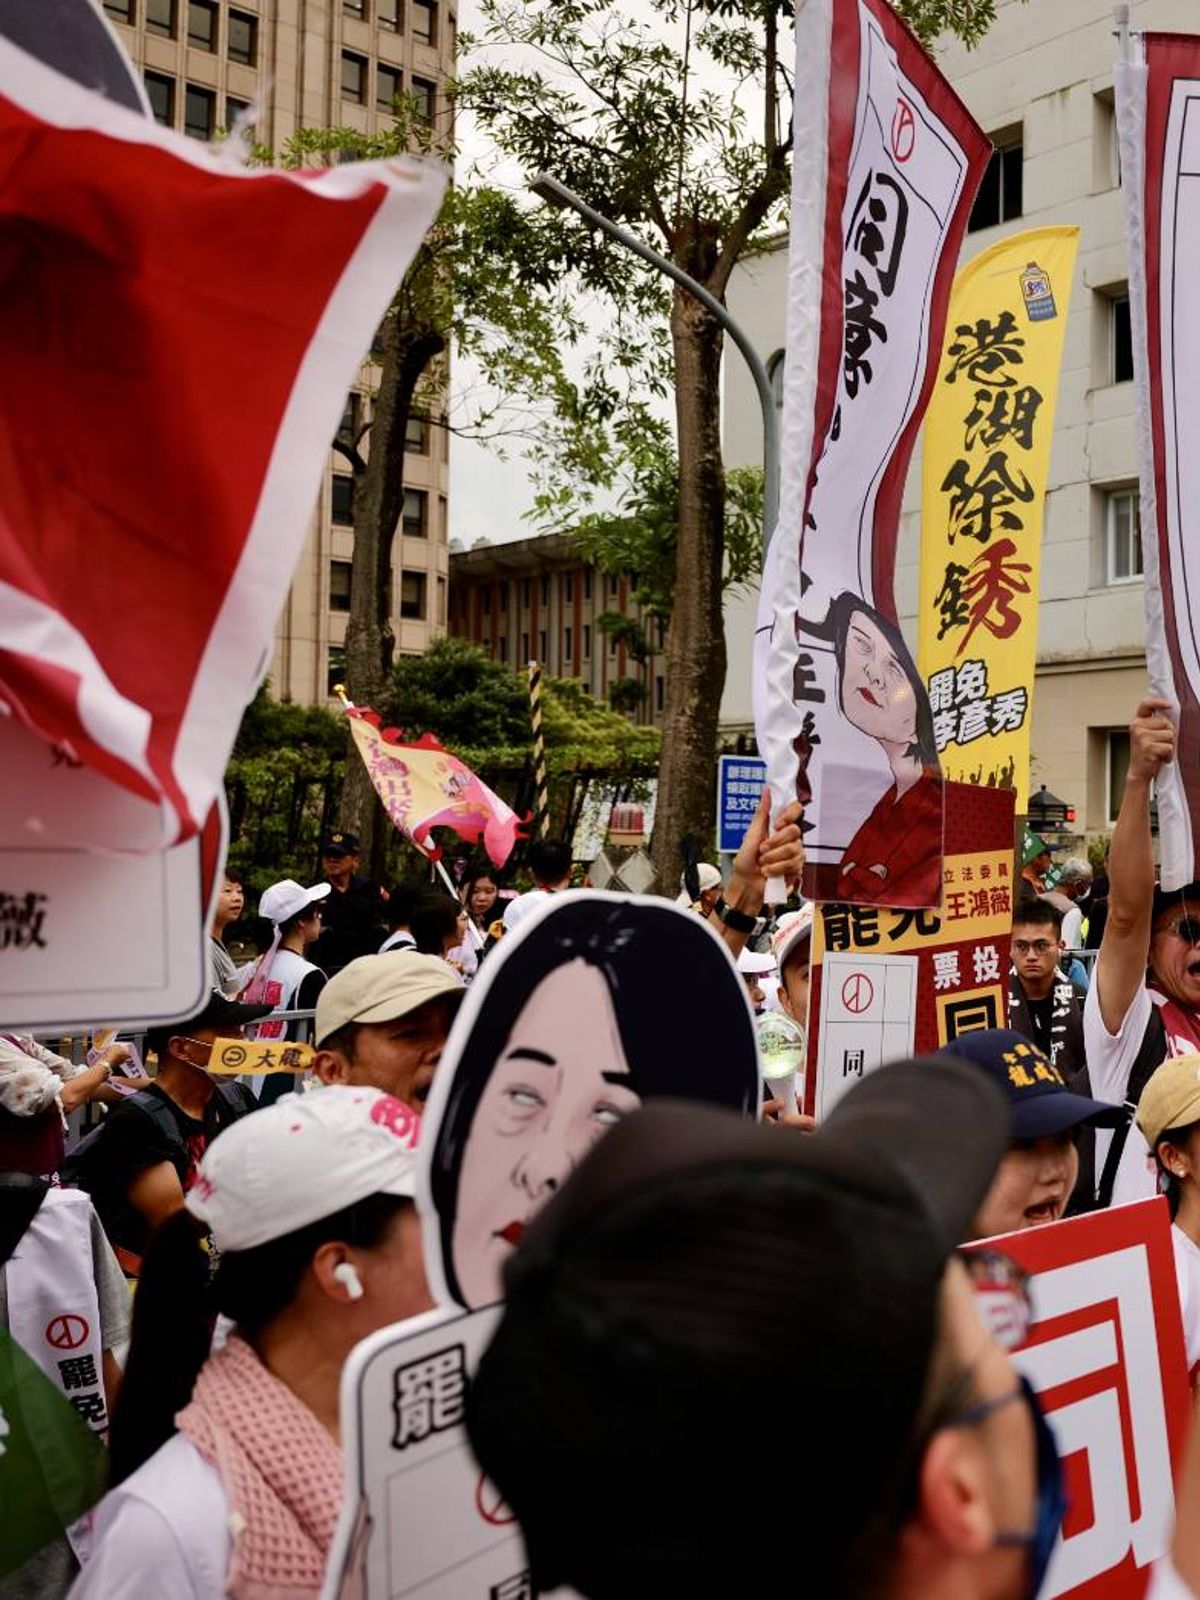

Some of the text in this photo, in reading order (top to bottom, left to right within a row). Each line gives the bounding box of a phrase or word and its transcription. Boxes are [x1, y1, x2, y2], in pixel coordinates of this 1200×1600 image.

[929, 659, 988, 711] 罷免
[930, 687, 1027, 752] 李彥秀
[946, 885, 1011, 922] 王鴻薇
[932, 945, 1000, 991] 票投
[843, 1049, 865, 1077] 同
